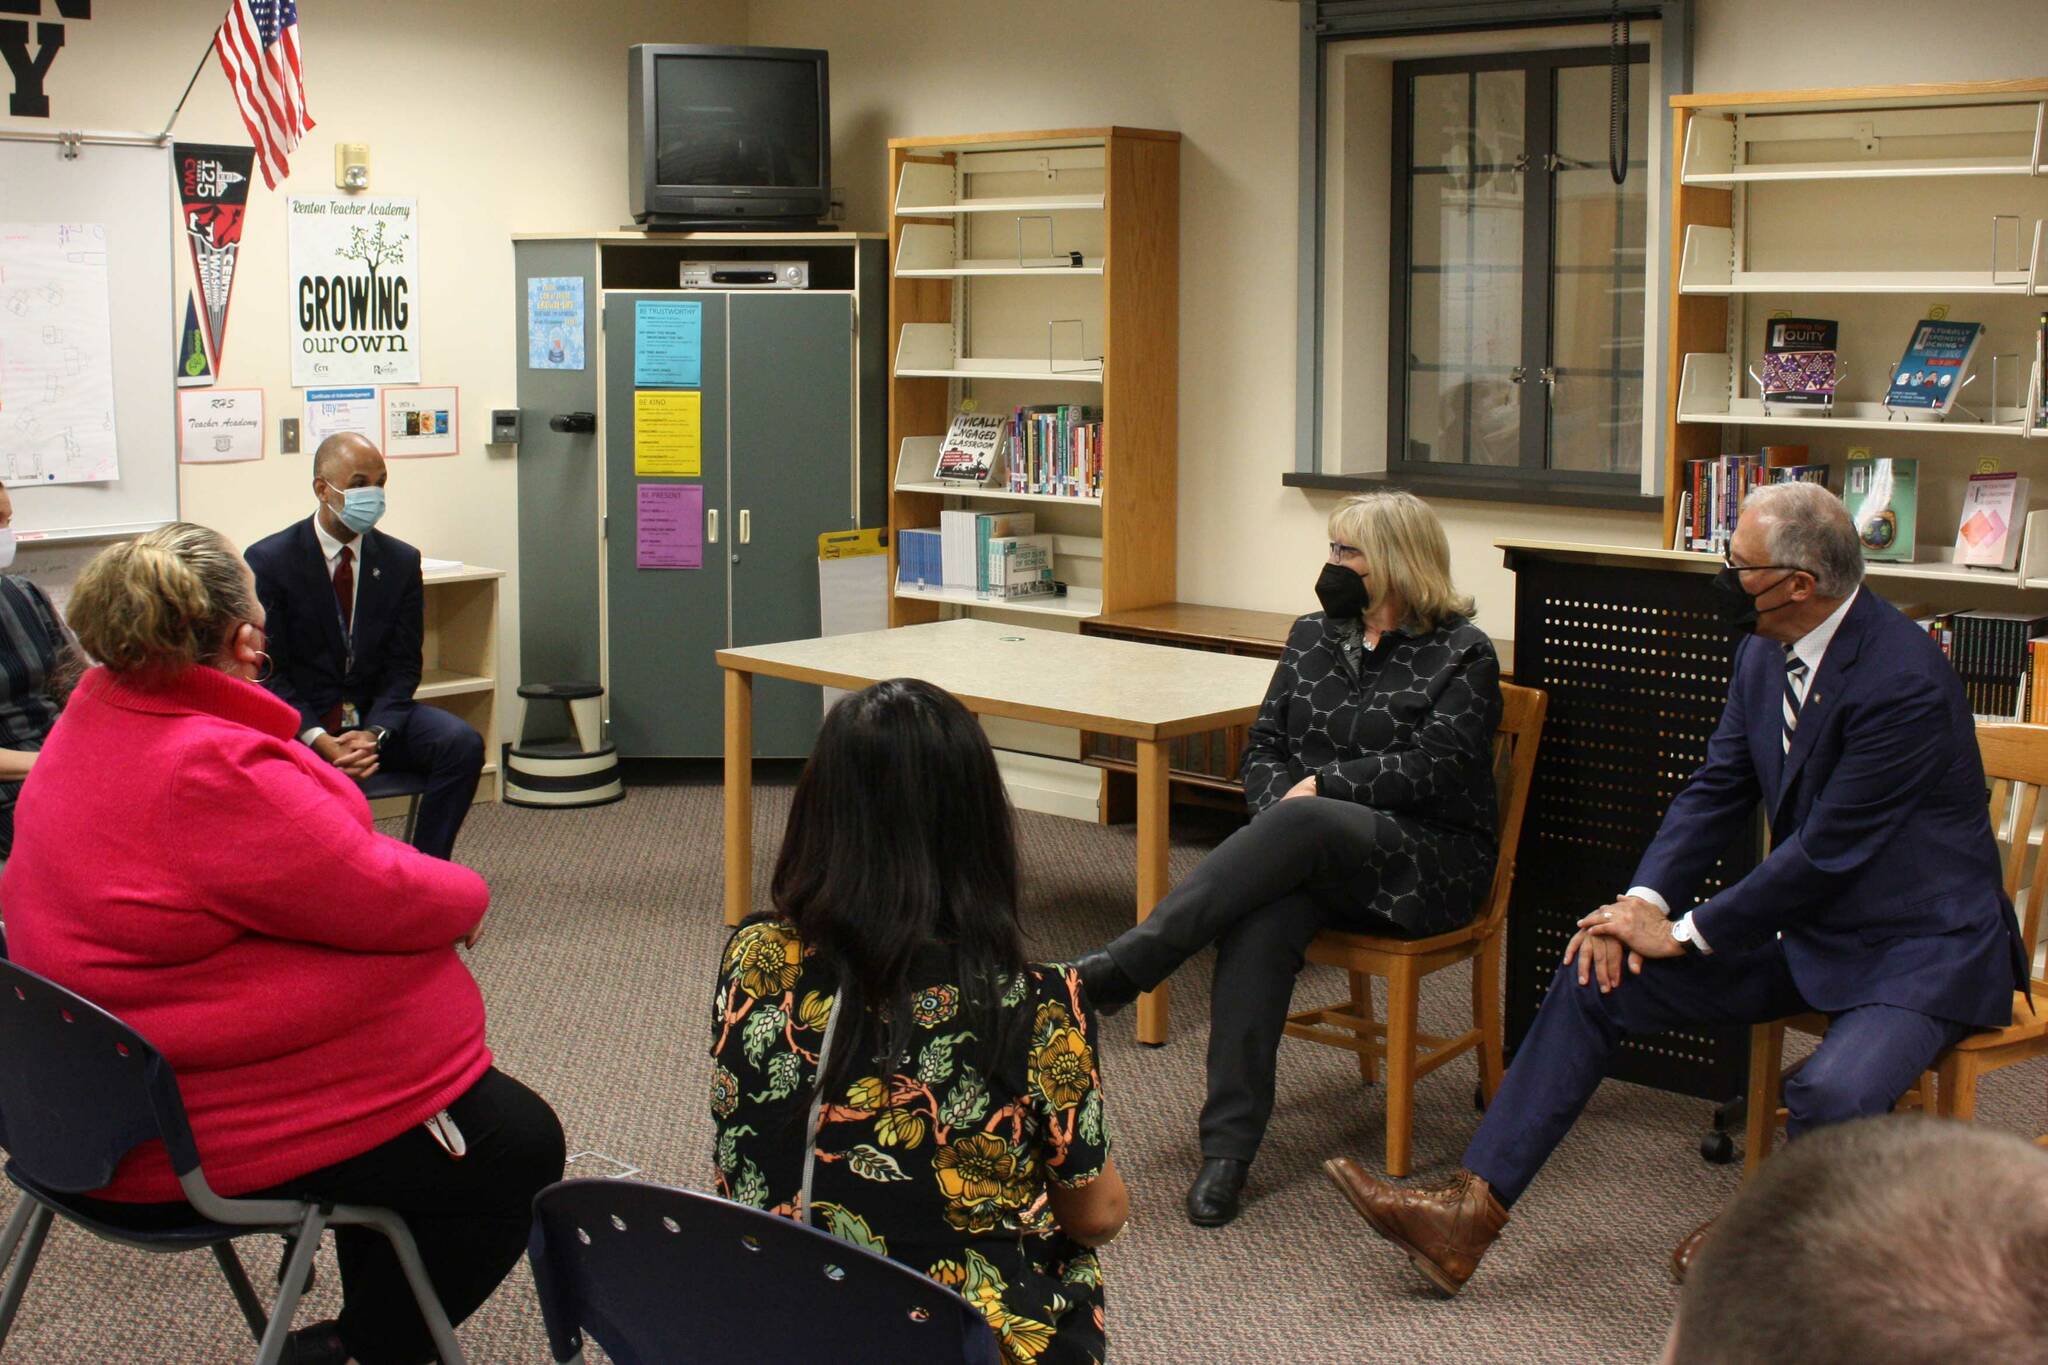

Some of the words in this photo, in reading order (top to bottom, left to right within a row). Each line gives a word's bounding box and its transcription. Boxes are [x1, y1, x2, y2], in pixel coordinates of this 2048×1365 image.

[184, 158, 197, 197] CWU
[197, 160, 215, 197] 125
[292, 200, 326, 215] Renton
[329, 200, 366, 216] Teacher
[367, 202, 410, 221] Academy
[299, 275, 408, 332] GROWING
[1785, 330, 1825, 342] QUITY
[210, 398, 235, 409] RHS
[649, 398, 666, 406] KIND
[188, 418, 219, 429] Teacher
[221, 417, 258, 428] Academy
[953, 427, 997, 441] NGAGED
[949, 438, 995, 450] CLASSROOM
